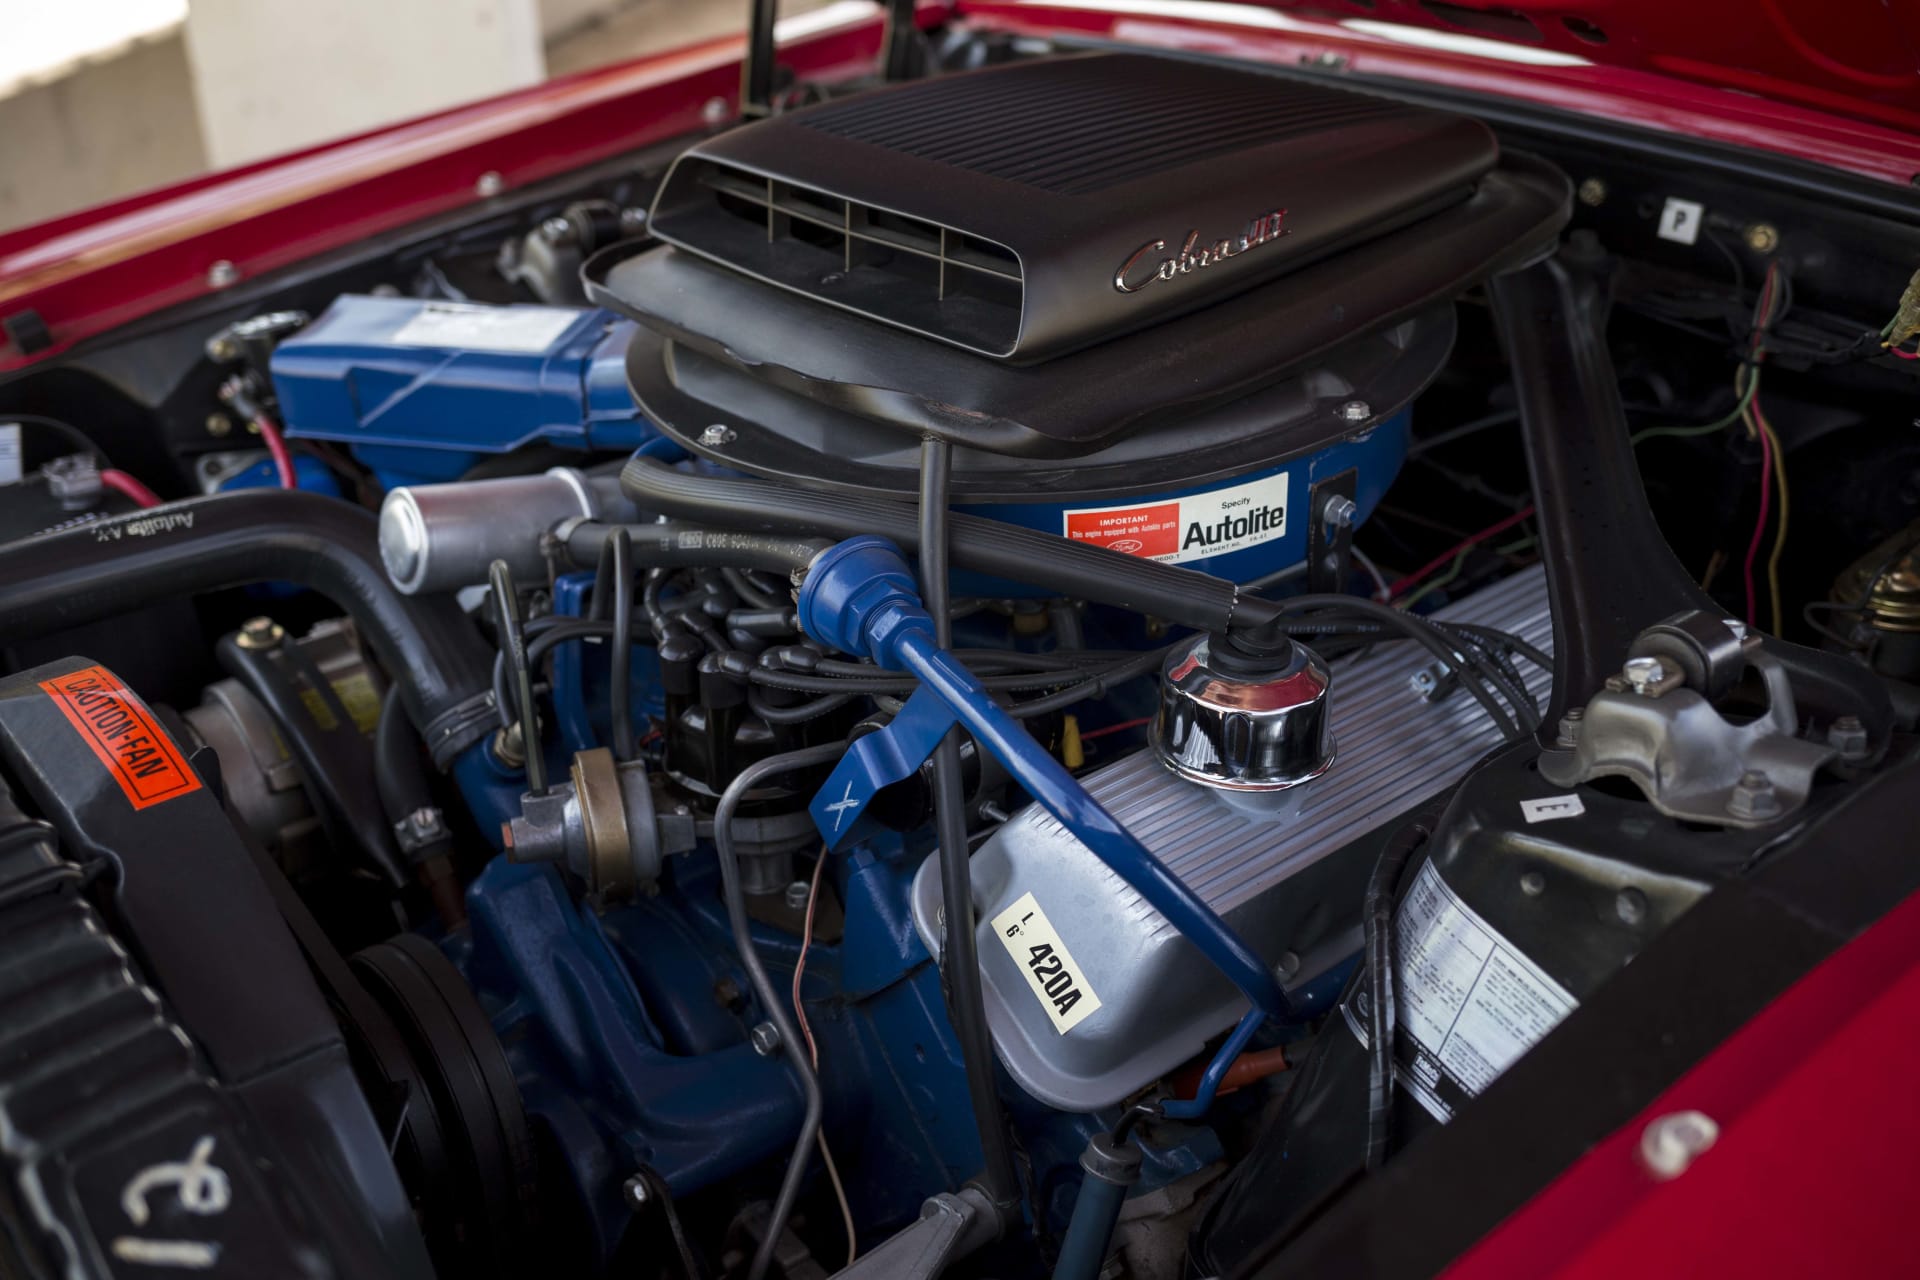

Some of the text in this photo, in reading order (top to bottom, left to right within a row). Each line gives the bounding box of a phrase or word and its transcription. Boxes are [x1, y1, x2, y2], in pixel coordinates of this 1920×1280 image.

[1671, 209, 1688, 233] P
[1112, 229, 1236, 294] Cobra
[1221, 497, 1251, 510] Specify
[1085, 530, 1101, 539] engine
[1104, 527, 1126, 537] equipped
[1128, 525, 1140, 534] with
[1142, 522, 1161, 533] Autolite
[1162, 520, 1177, 531] parts
[1099, 515, 1149, 527] IMPORTANT
[1182, 505, 1284, 551] Autolite
[1200, 543, 1231, 556] ELEMENT
[64, 677, 170, 779] CAUTION-FAN
[1021, 911, 1034, 926] L
[1028, 943, 1083, 1017] 420A
